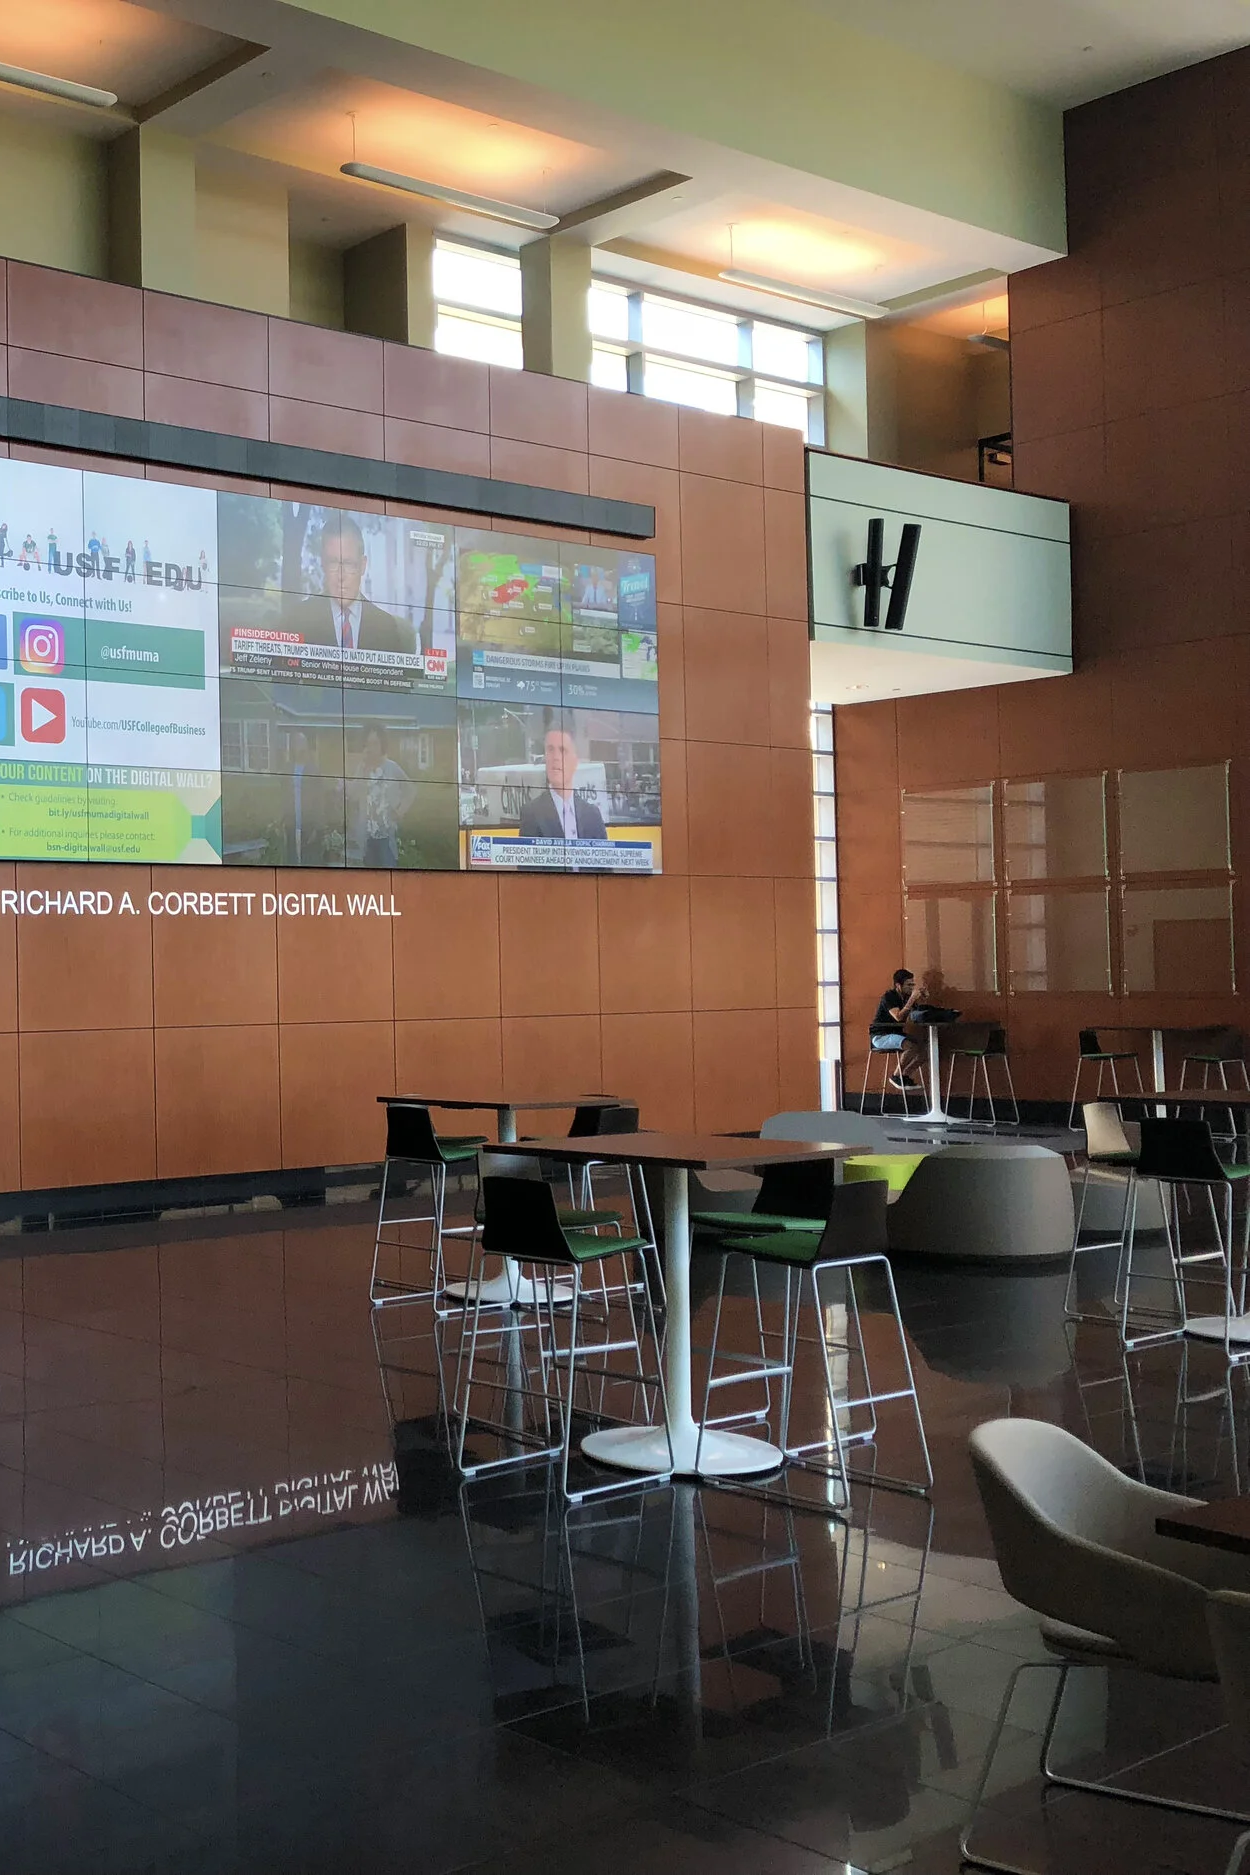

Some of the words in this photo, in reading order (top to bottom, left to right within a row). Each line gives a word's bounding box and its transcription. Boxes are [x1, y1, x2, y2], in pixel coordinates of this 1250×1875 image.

[27, 591, 37, 602] to
[40, 591, 53, 606] Us,
[56, 593, 93, 608] Connect
[96, 596, 116, 612] with
[119, 599, 132, 613] Us!
[234, 628, 299, 642] #INSIDEPOLITICS
[101, 645, 159, 663] @usfmuma
[234, 640, 254, 650] TARIFF
[310, 647, 340, 658] WARNINGS
[350, 651, 364, 660] NATO
[366, 654, 375, 662] PUT
[378, 655, 395, 664] ALLIES
[397, 656, 404, 665] ON
[406, 657, 420, 666] EDGE
[235, 654, 248, 662] Jeff
[322, 662, 340, 670] White
[360, 666, 403, 676] Correspondent
[426, 660, 445, 672] CNN
[72, 716, 205, 736] YouTube.com/USFCollegeofBusiness
[28, 764, 84, 782] CONTENT
[88, 768, 102, 783] ON
[105, 768, 128, 784] THE
[131, 770, 173, 786] DIGITAL
[8, 792, 33, 802] Check
[9, 828, 22, 836] For
[24, 827, 64, 838] additional
[1, 890, 112, 915] RICHARD
[119, 892, 140, 915] A.
[148, 892, 256, 916] CORBETT
[262, 893, 343, 916] DIGITAL
[347, 894, 401, 916] WALL
